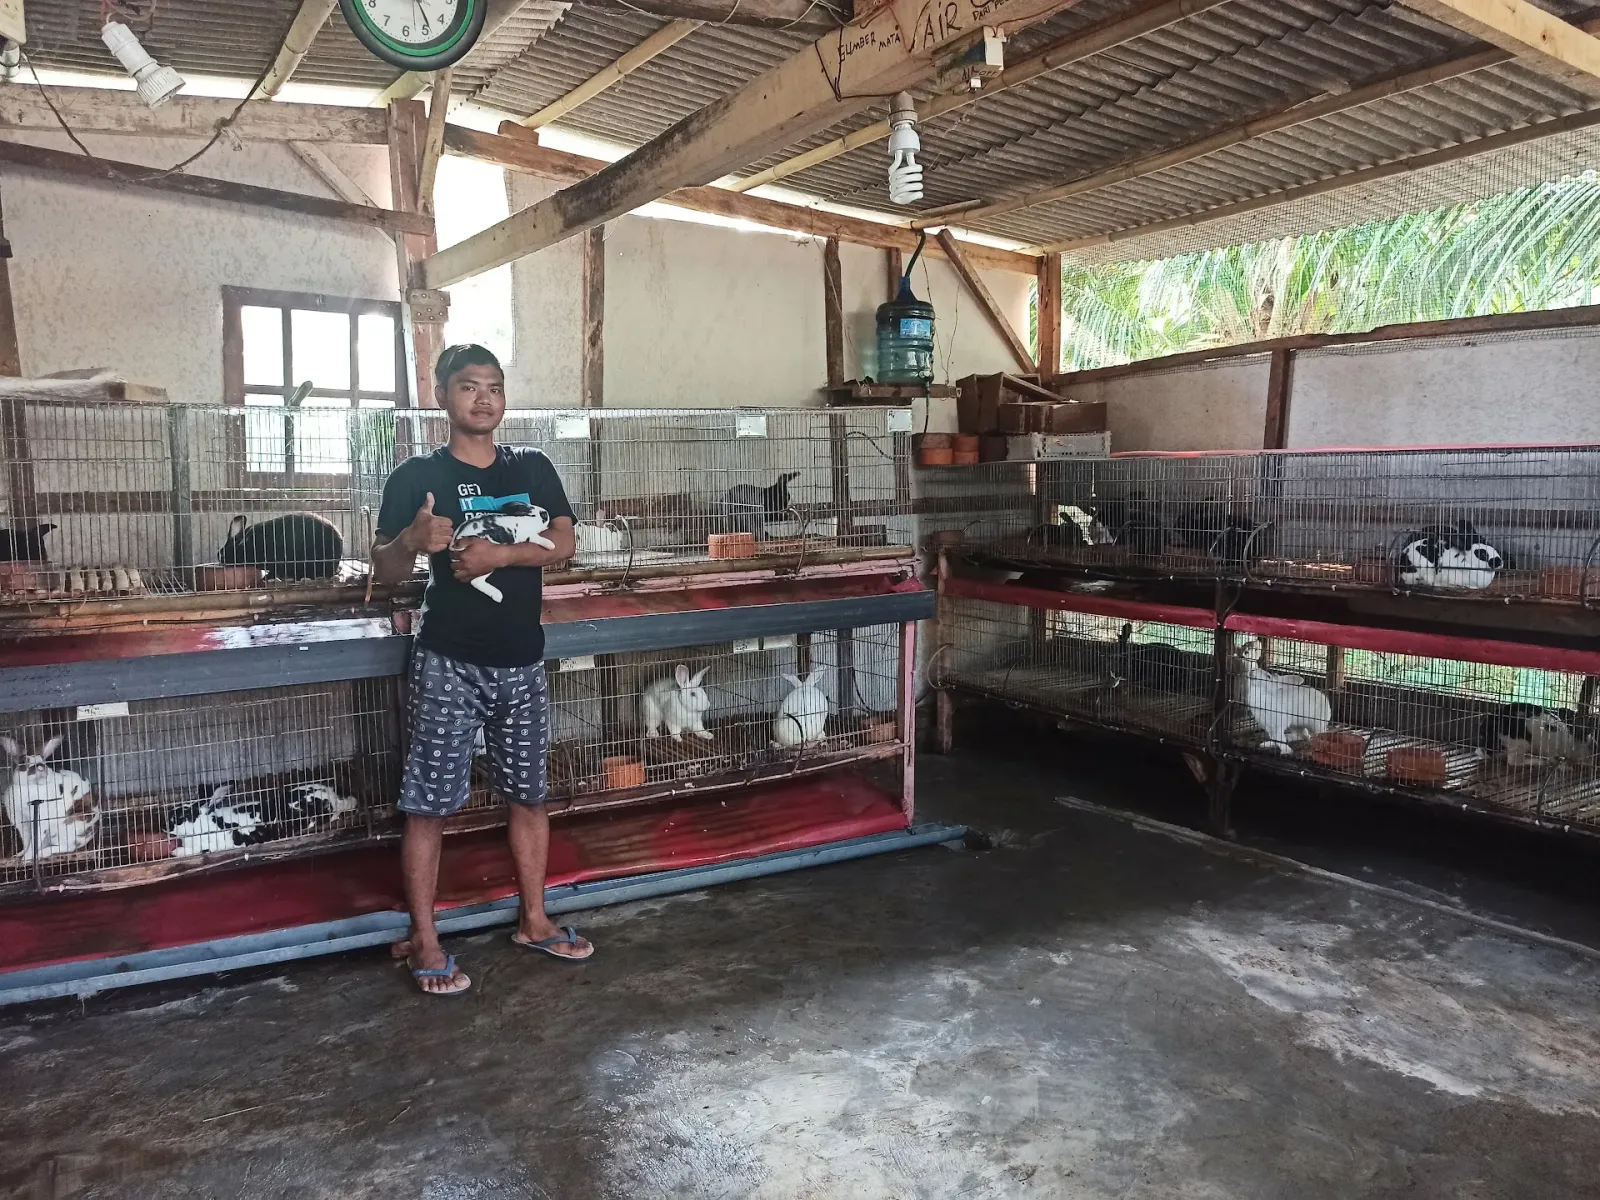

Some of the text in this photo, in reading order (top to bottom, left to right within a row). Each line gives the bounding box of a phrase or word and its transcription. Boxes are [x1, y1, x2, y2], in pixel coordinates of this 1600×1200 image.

[437, 13, 445, 25] 4
[972, 5, 991, 21] DARI
[383, 14, 391, 27] 7
[402, 25, 410, 37] 6
[421, 24, 430, 36] 5
[878, 32, 901, 52] MATA
[457, 483, 482, 497] GET
[461, 498, 474, 510] IT
